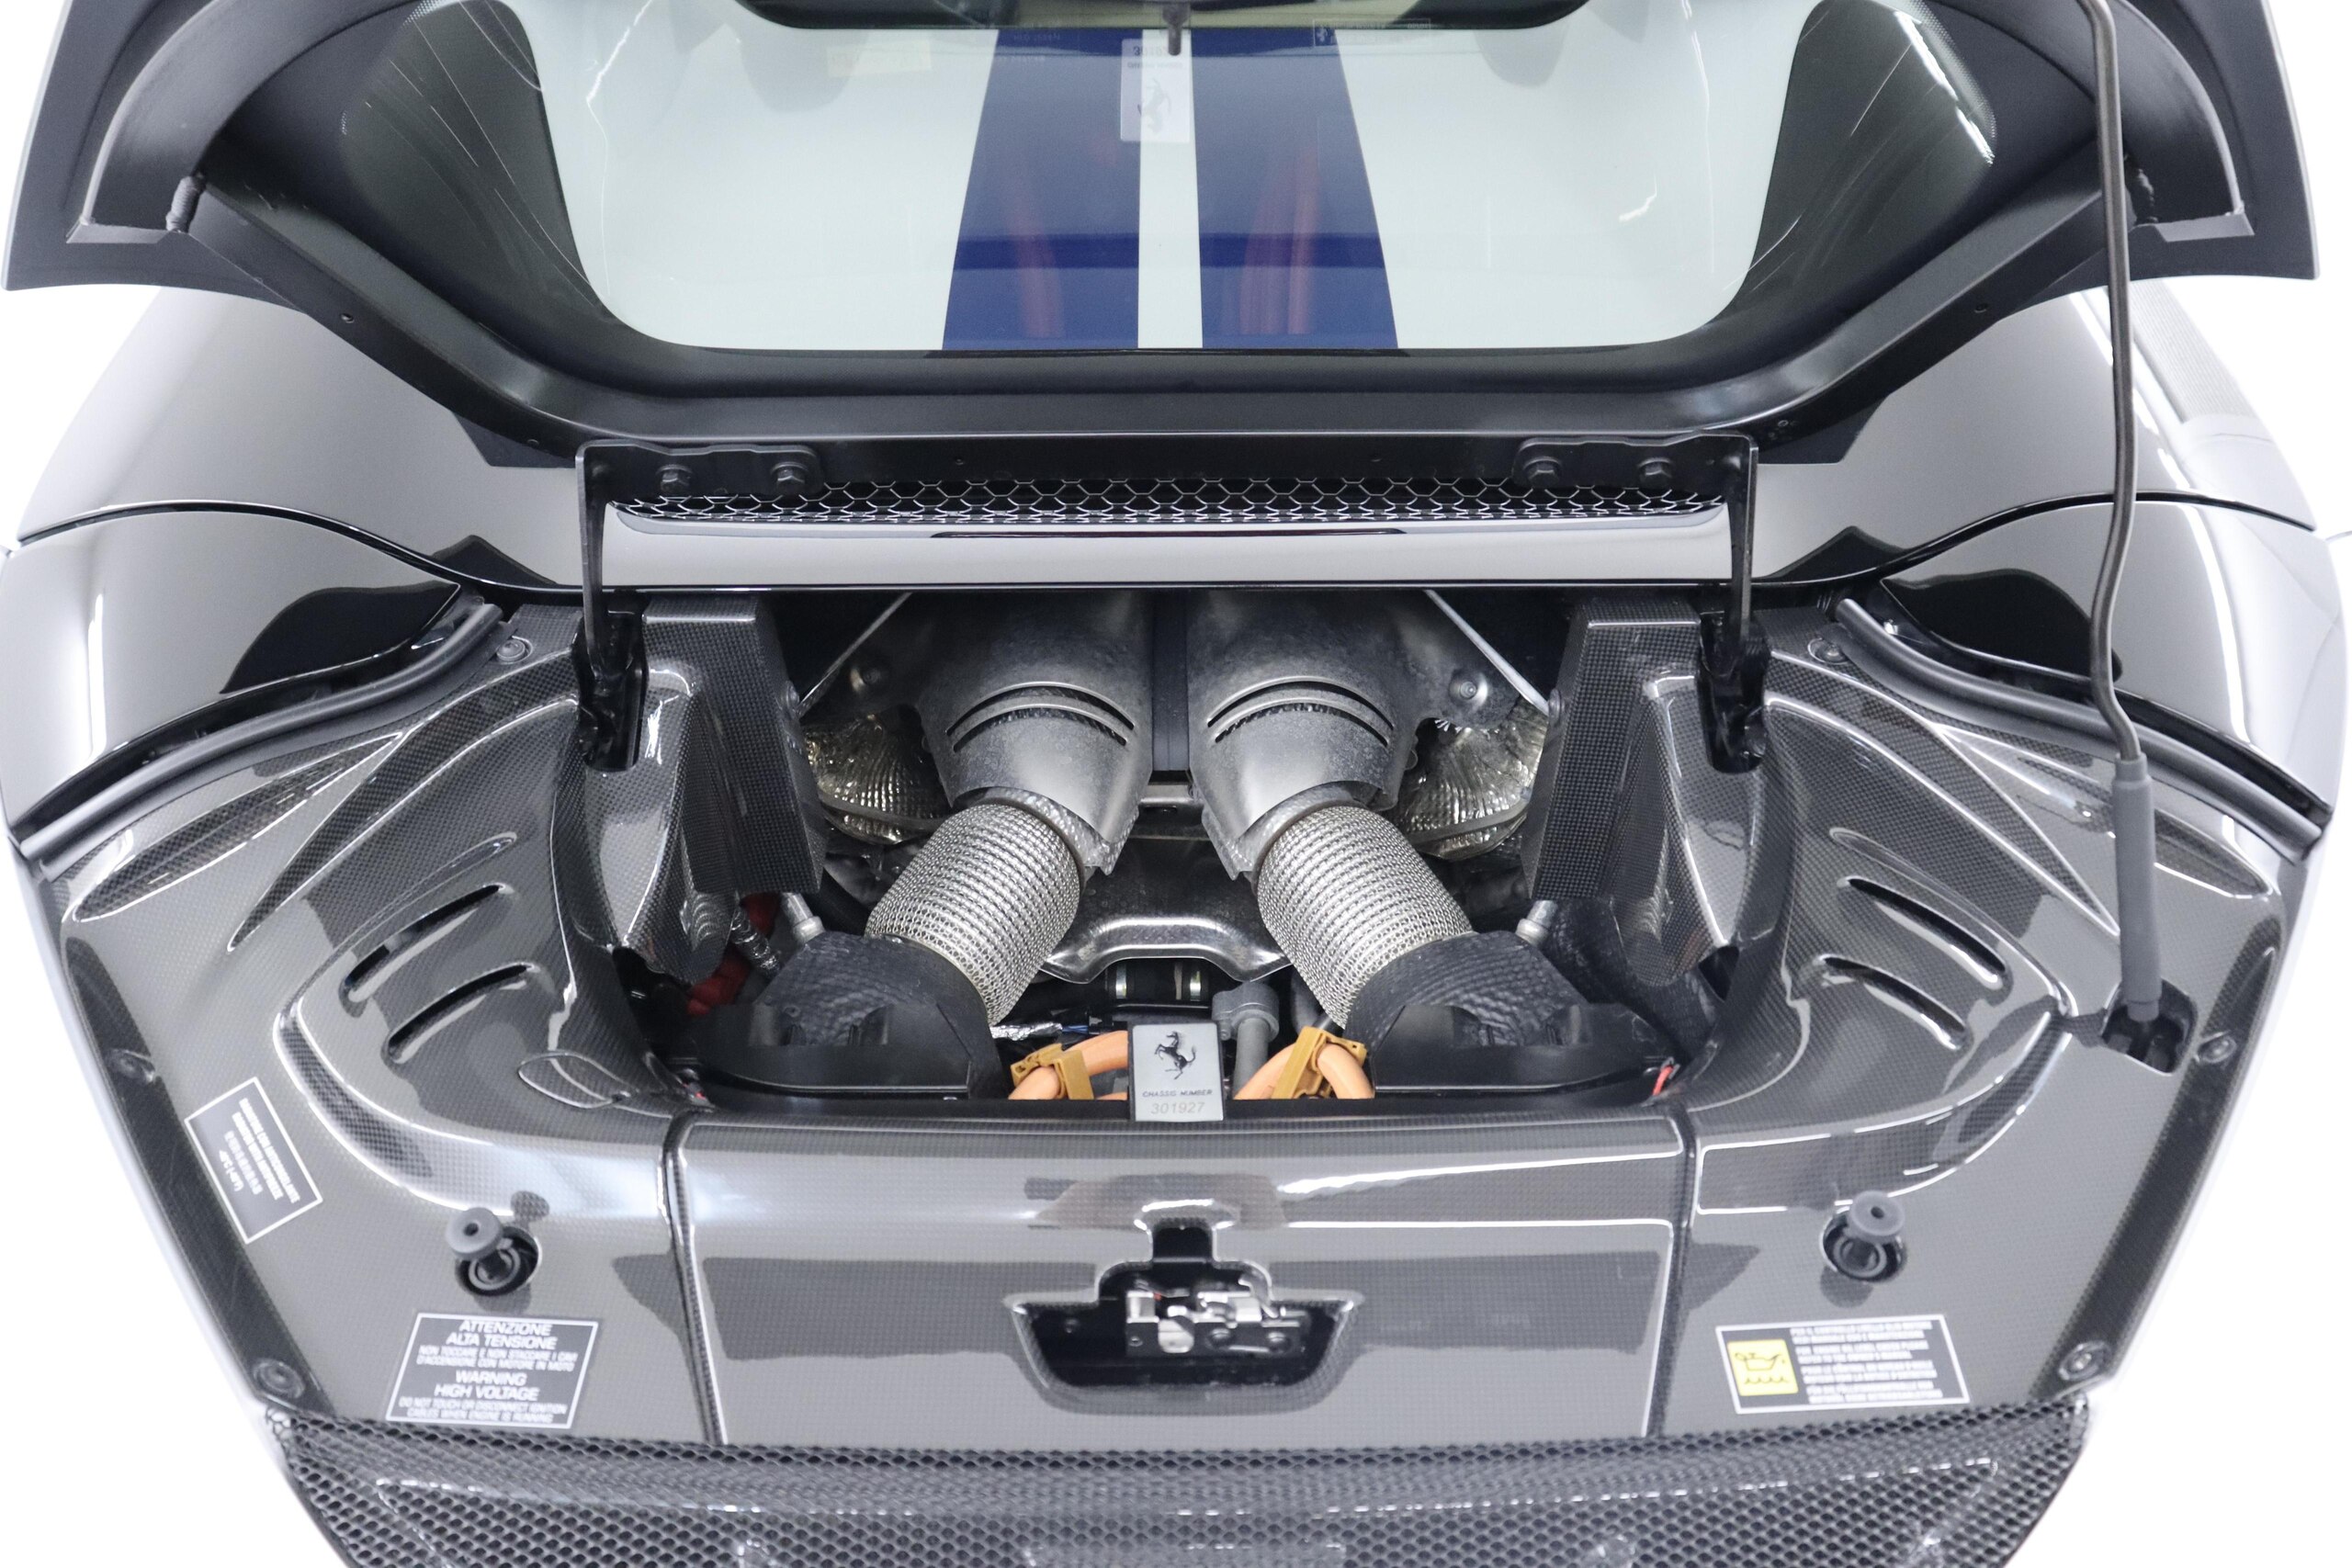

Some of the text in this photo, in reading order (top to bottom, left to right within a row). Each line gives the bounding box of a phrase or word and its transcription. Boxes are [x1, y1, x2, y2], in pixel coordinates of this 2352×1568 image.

[1150, 1101, 1205, 1115] 301927
[459, 1320, 553, 1336] ATTENZIONE
[446, 1332, 558, 1350] ALTA TENSIONE
[456, 1370, 527, 1386] WARNING
[434, 1383, 540, 1401] HIGH VOLTAGE
